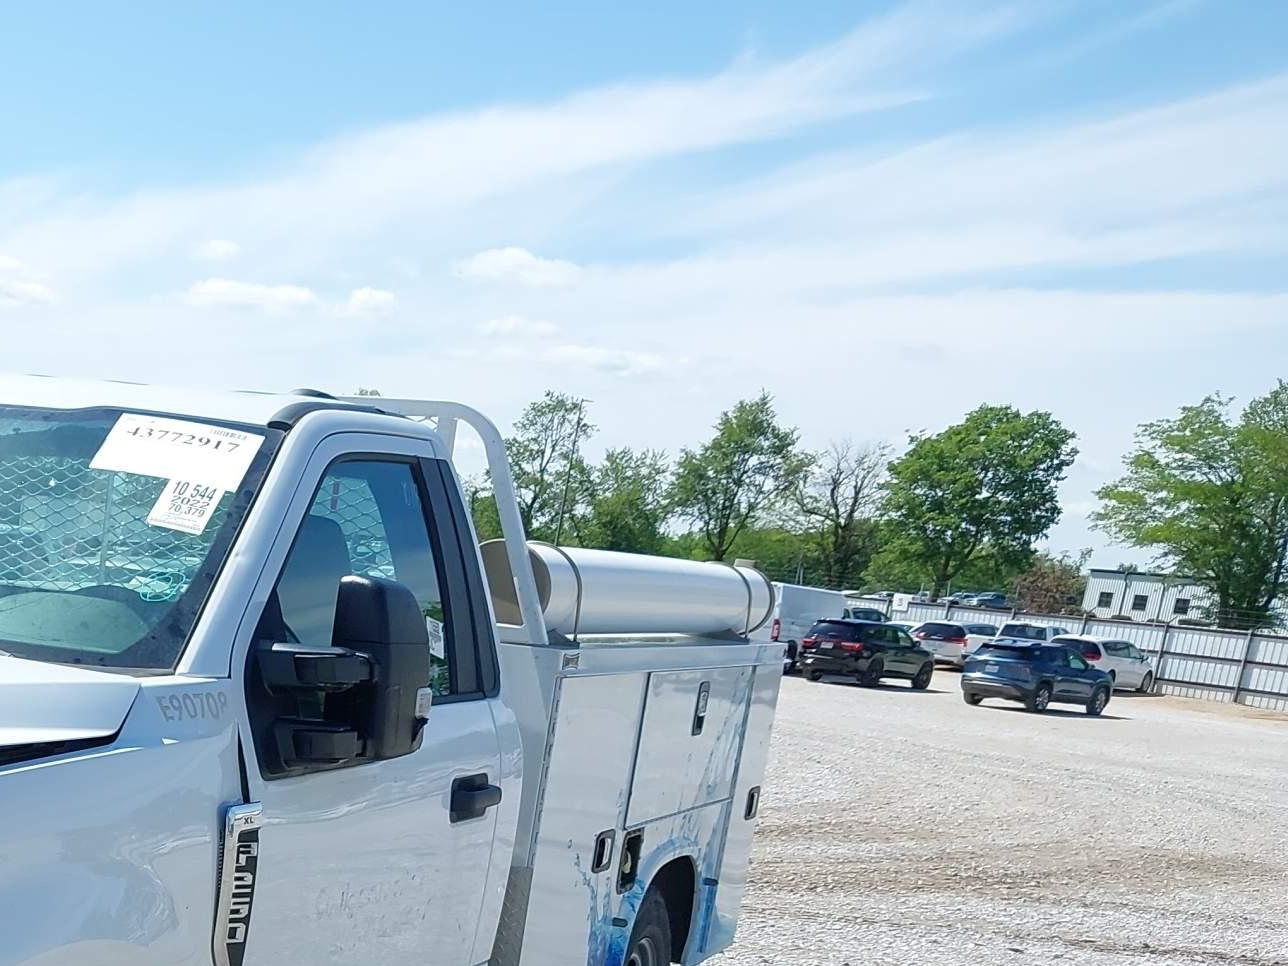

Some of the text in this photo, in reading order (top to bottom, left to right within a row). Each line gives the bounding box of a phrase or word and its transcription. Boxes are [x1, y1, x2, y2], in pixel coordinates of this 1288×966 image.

[126, 426, 240, 453] 43772917
[172, 480, 218, 502] 10 544
[170, 495, 210, 510] 2022
[243, 816, 255, 825] XL
